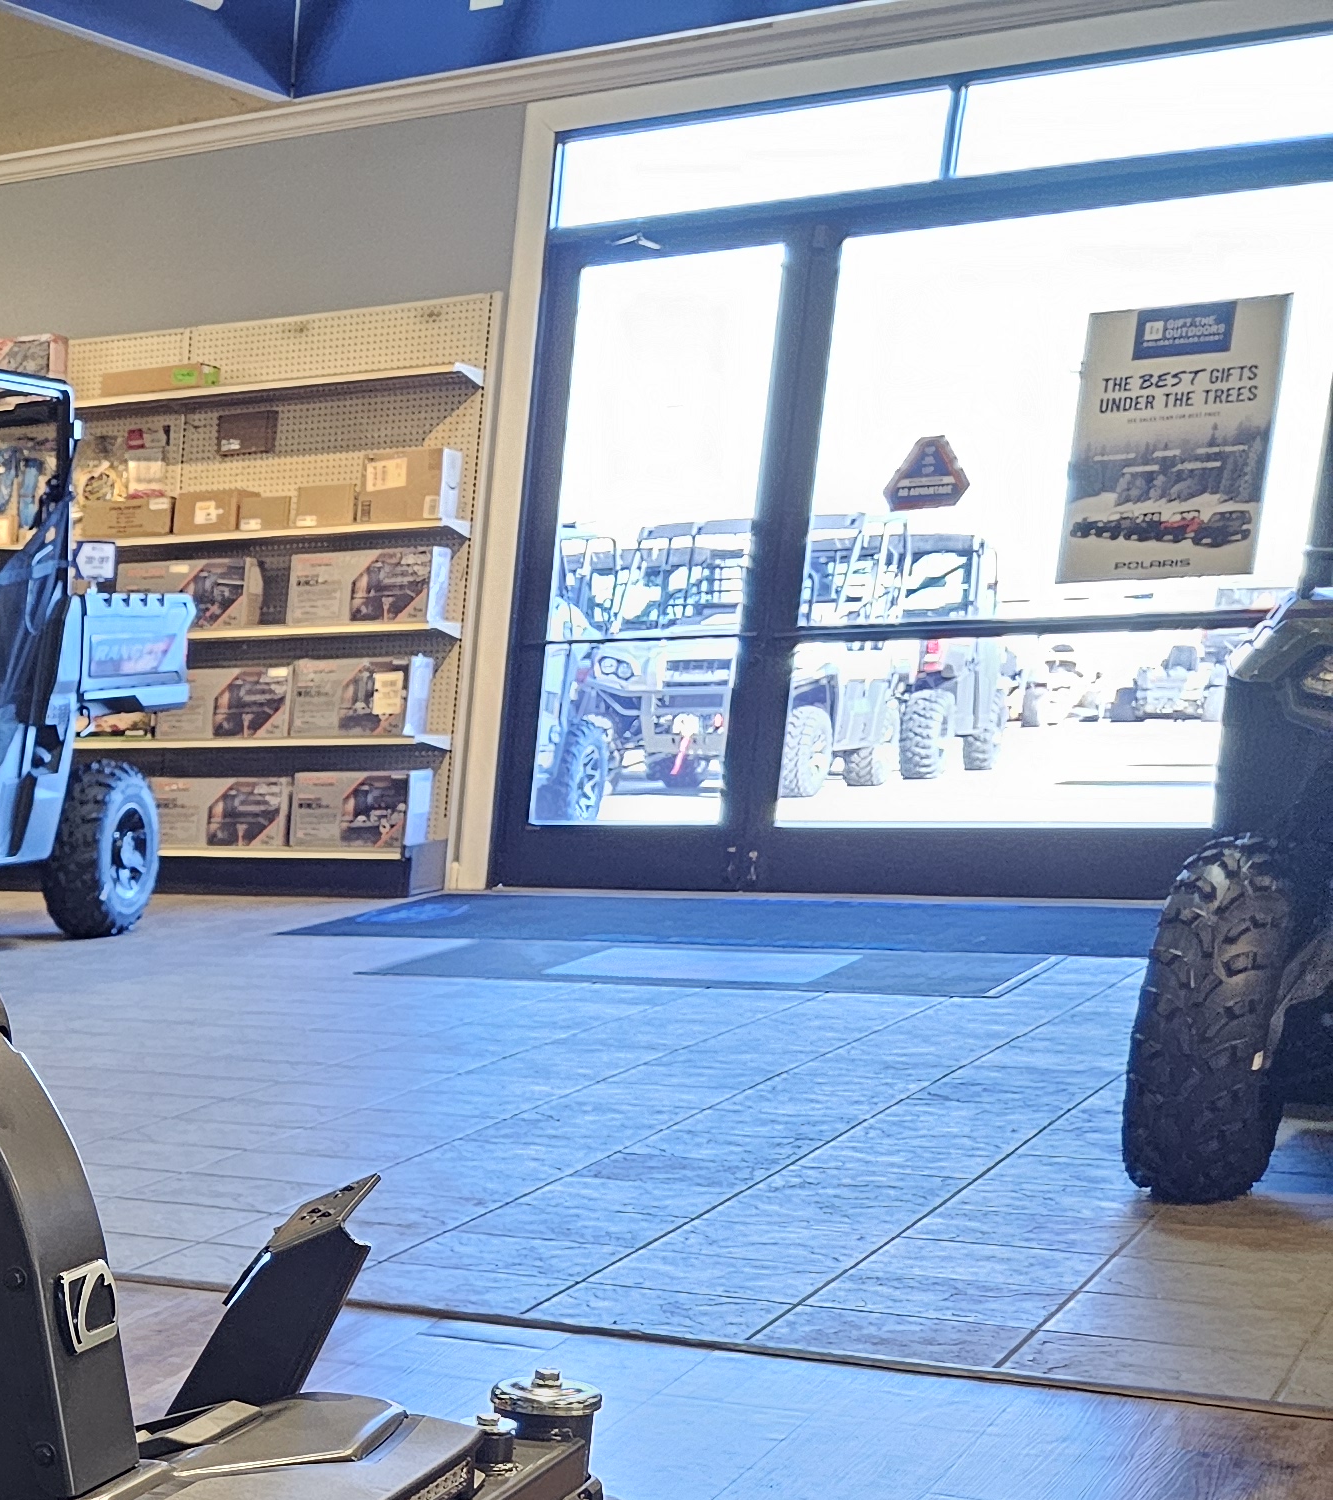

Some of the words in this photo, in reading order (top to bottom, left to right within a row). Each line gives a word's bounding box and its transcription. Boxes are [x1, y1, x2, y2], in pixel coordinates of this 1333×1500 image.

[1166, 318, 1193, 329] GIFT
[1195, 315, 1217, 325] THE
[1165, 323, 1226, 338] OUTDOORS
[1102, 376, 1134, 393] THE
[1139, 368, 1207, 390] BEST
[1209, 364, 1259, 384] GIFTS
[1099, 394, 1155, 413] UNDER
[1163, 391, 1196, 409] THE
[1202, 386, 1259, 405] TREES
[1113, 558, 1191, 571] POLARIS
